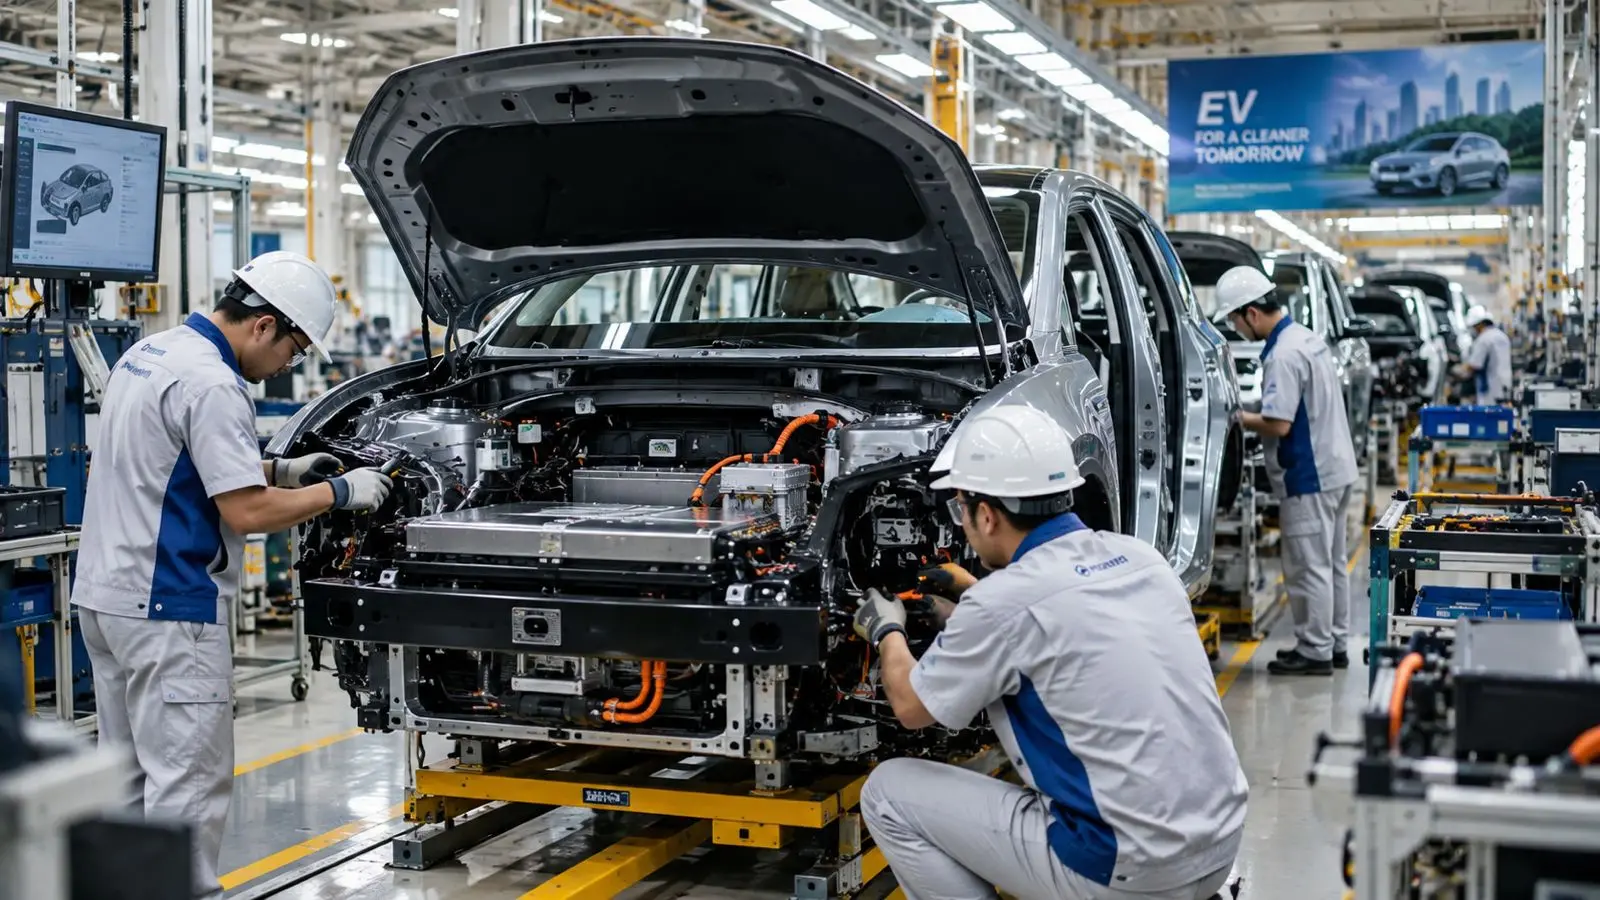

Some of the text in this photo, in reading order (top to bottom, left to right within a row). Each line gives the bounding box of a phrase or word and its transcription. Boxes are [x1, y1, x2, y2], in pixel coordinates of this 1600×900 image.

[1197, 89, 1258, 126] EV
[1195, 127, 1310, 145] FOR A CLEANER
[1195, 145, 1304, 164] TOMORROW
